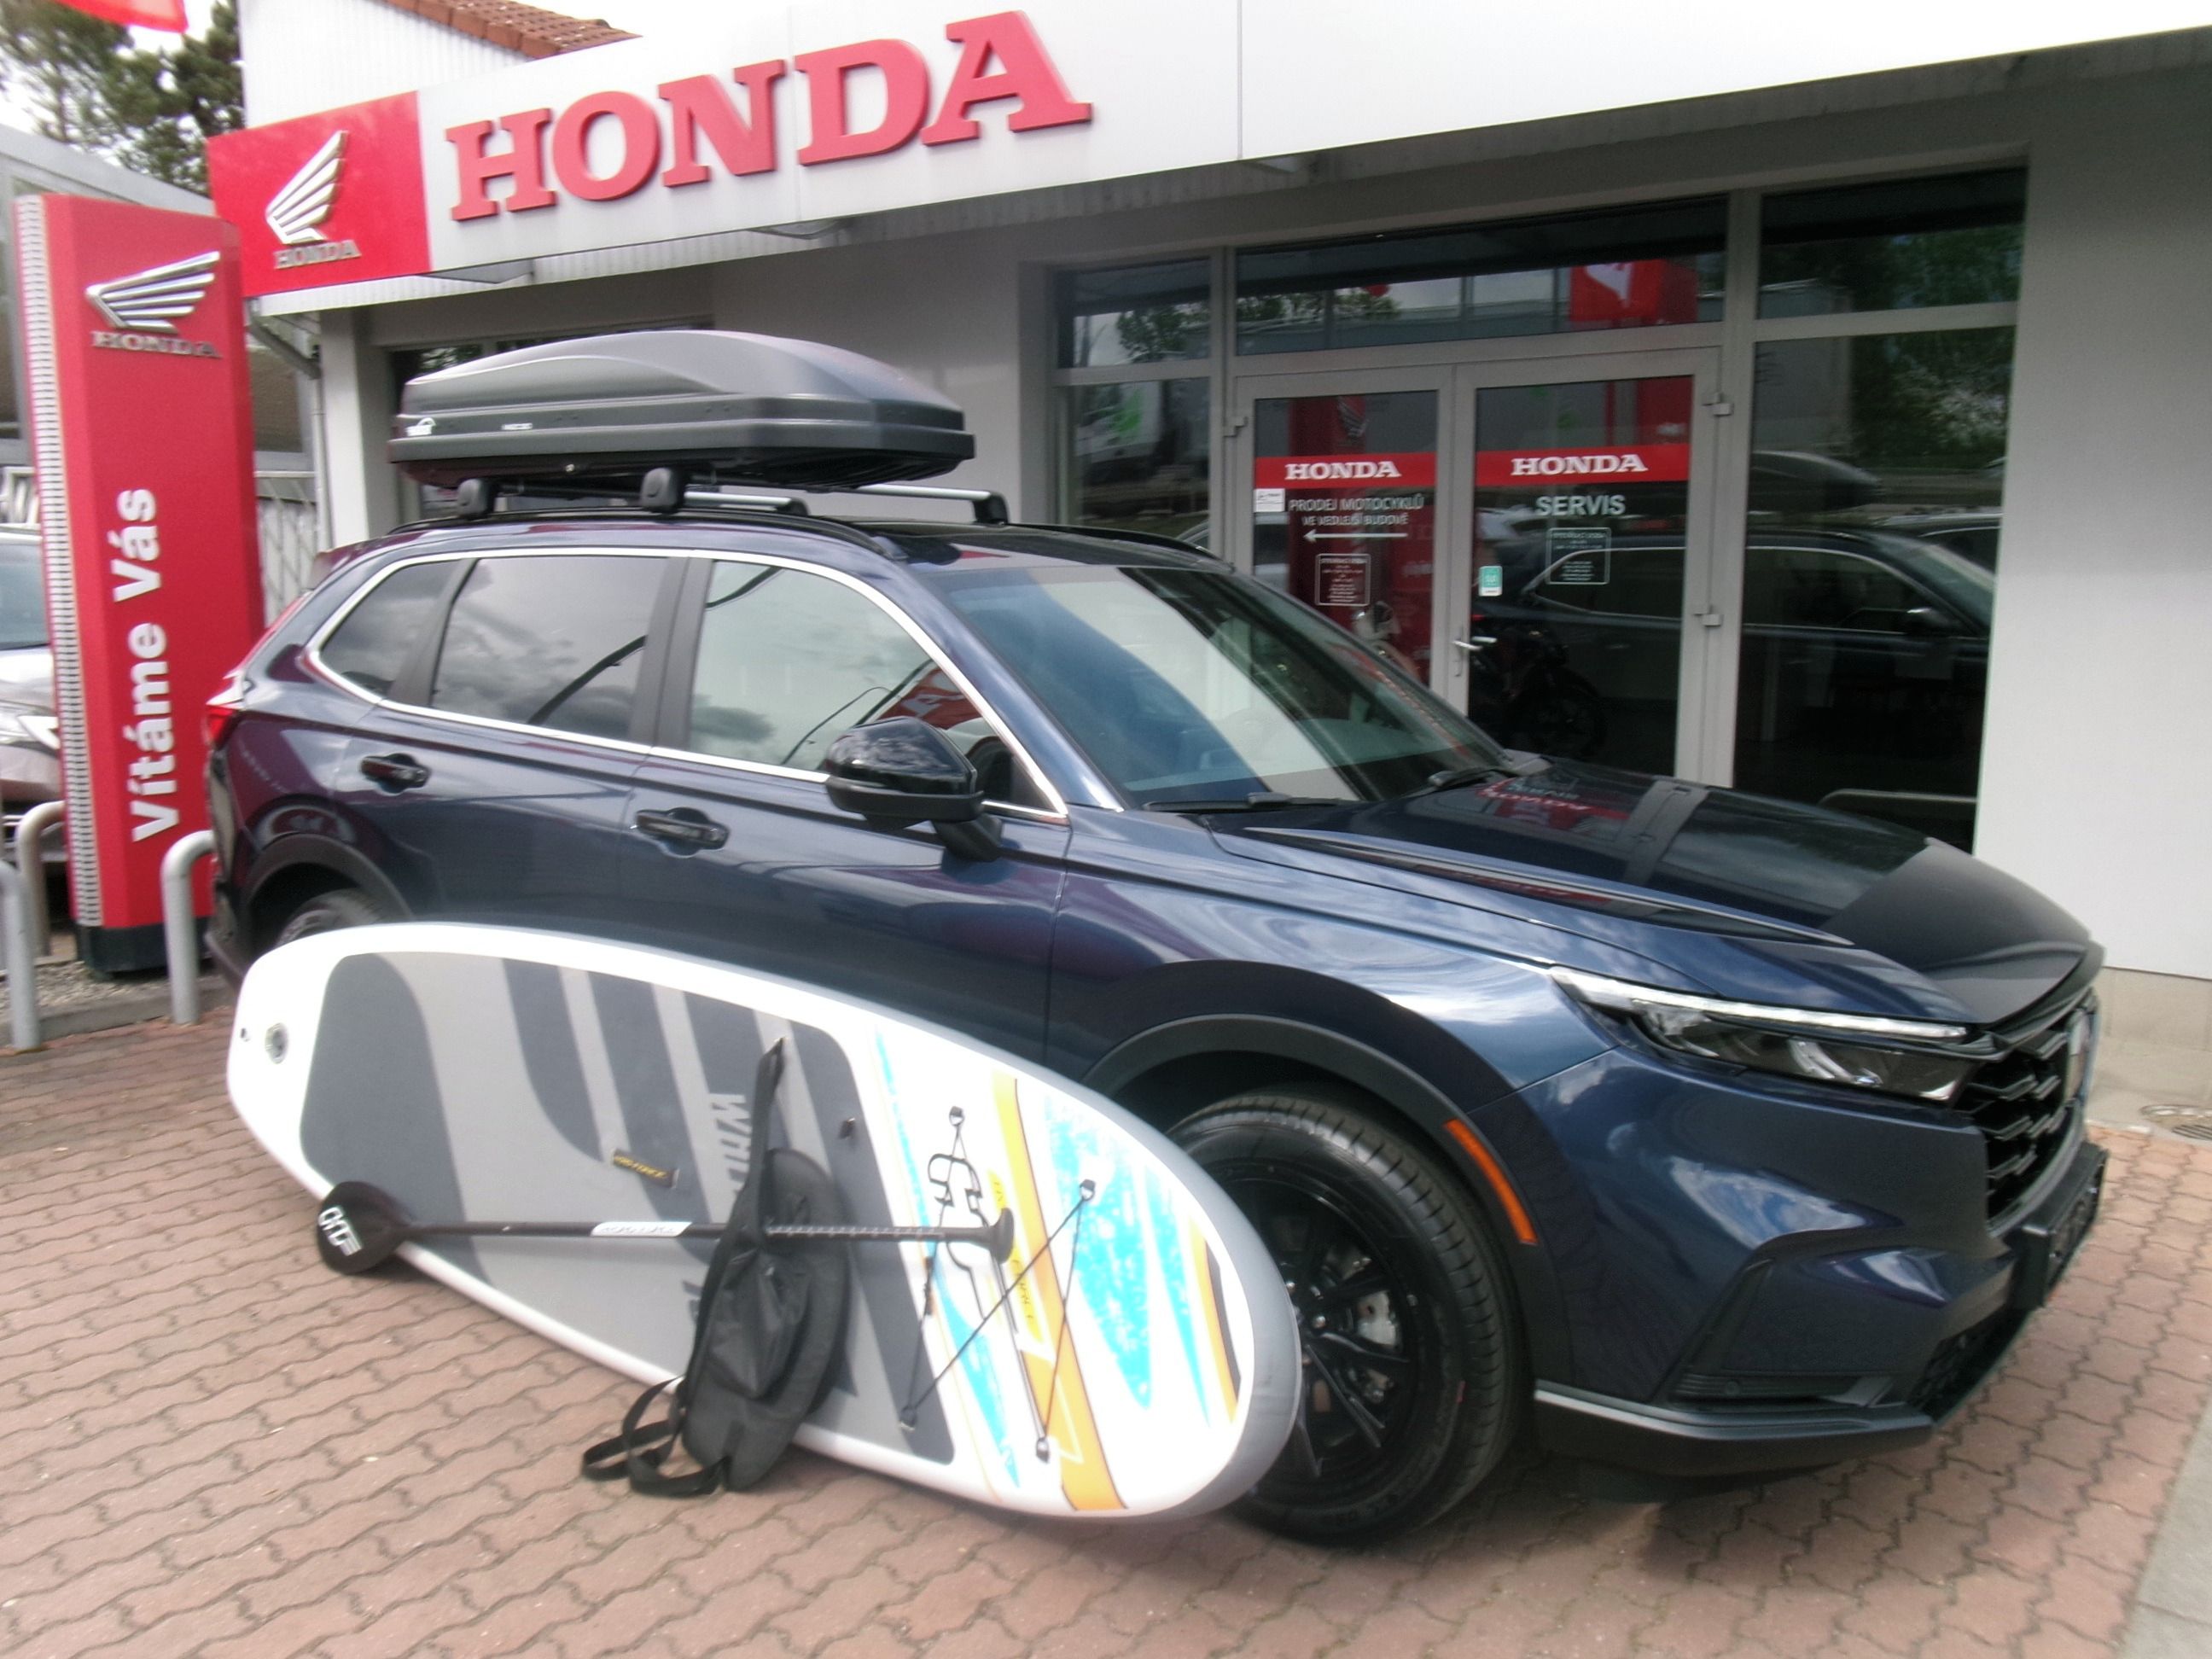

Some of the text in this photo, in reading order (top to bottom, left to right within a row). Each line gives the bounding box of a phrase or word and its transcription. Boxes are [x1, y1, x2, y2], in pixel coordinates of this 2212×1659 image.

[445, 9, 1092, 222] HONDA
[274, 239, 362, 270] HONDA
[91, 329, 222, 359] HONDA
[1284, 460, 1402, 480] HONDA
[1511, 453, 1649, 475] HONDA
[1289, 498, 1337, 512] PRODEJ
[1535, 494, 1627, 515] SERVIS
[107, 488, 180, 843] Vítáme Vás
